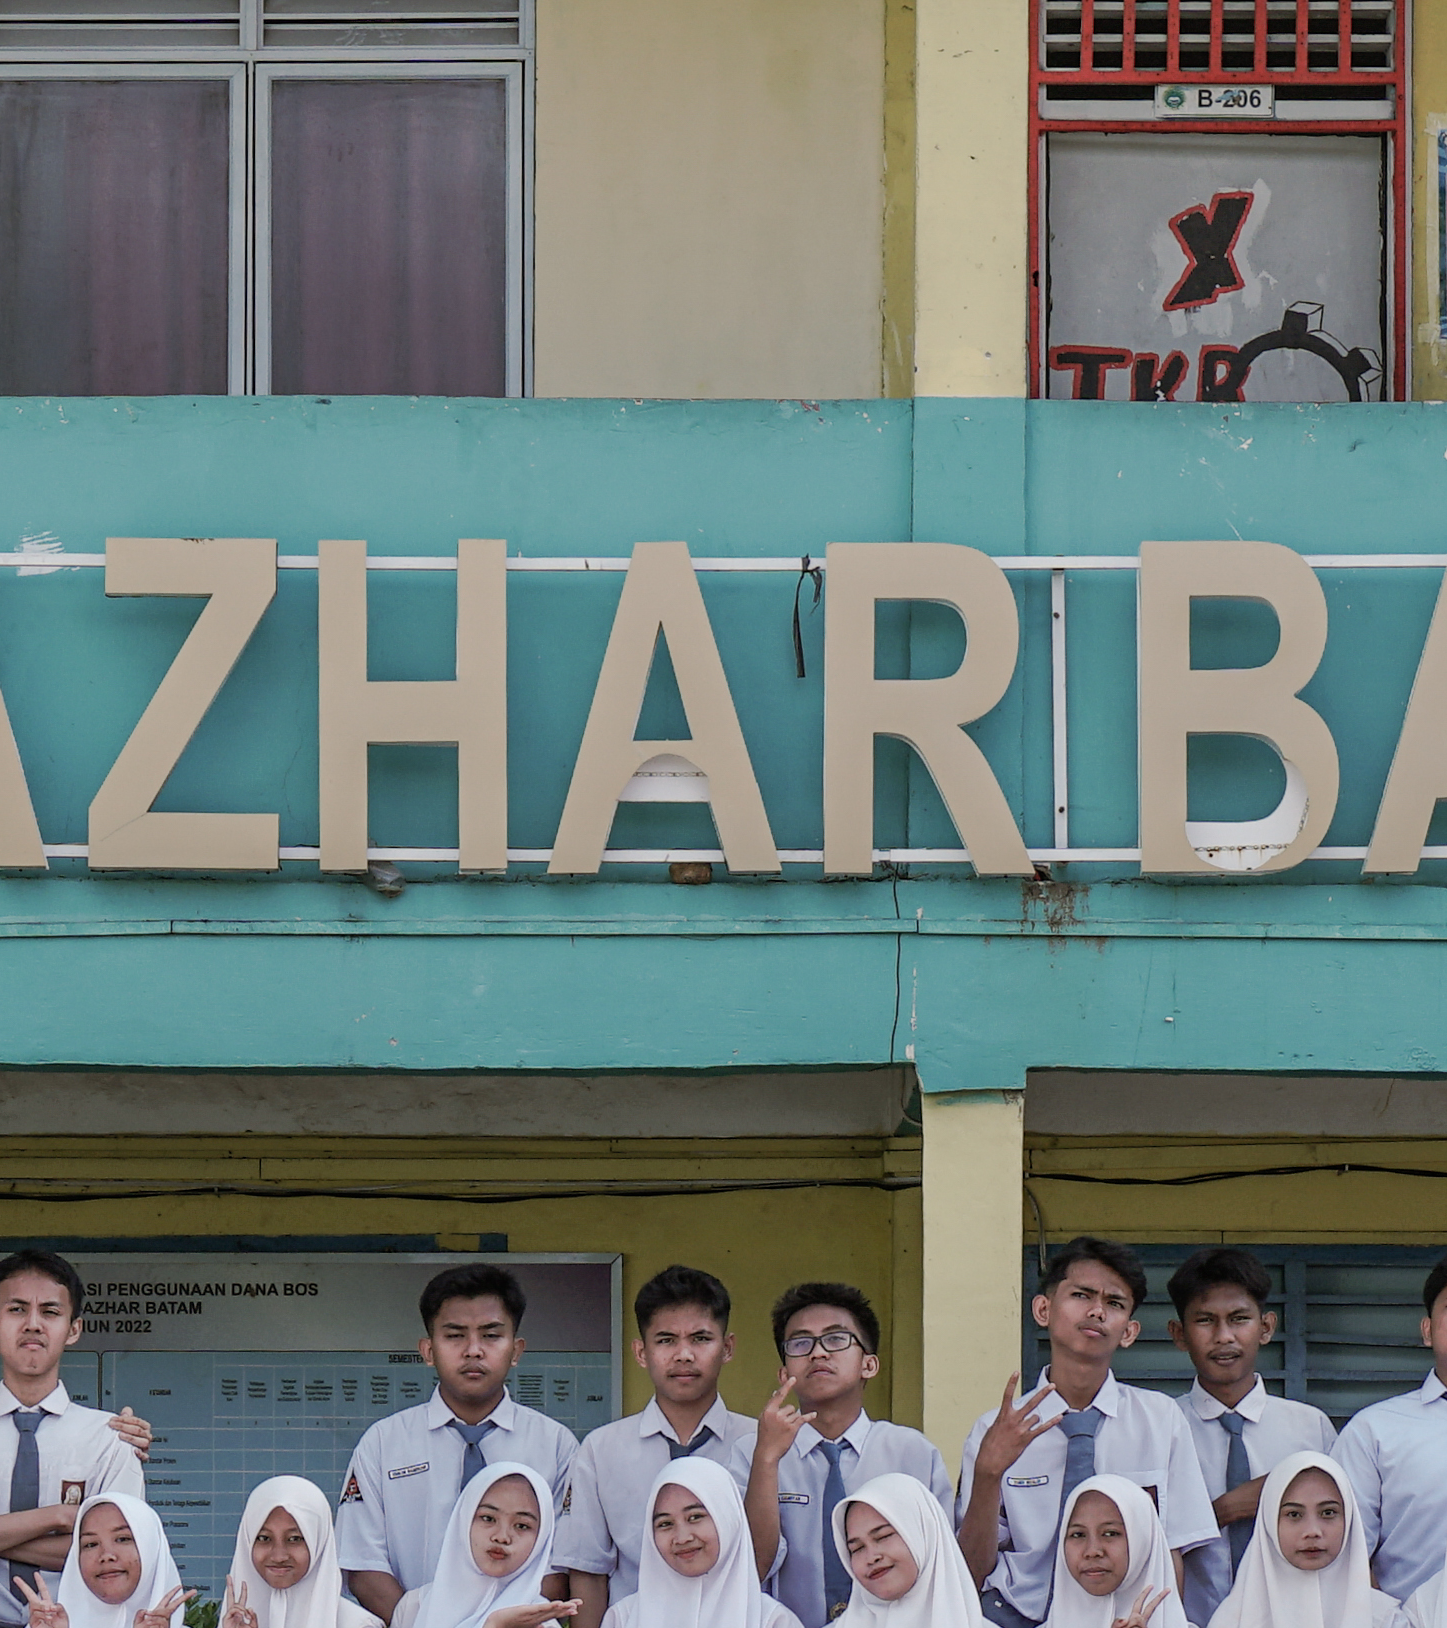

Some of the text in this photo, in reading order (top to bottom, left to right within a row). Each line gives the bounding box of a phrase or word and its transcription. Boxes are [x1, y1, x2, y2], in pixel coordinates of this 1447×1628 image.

[1197, 88, 1262, 109] B-206
[107, 1283, 226, 1296] PENGGUNAAN
[231, 1283, 278, 1297] DANA
[283, 1283, 319, 1296] BOS
[148, 1301, 202, 1315] BATAM
[115, 1319, 152, 1333] 2022
